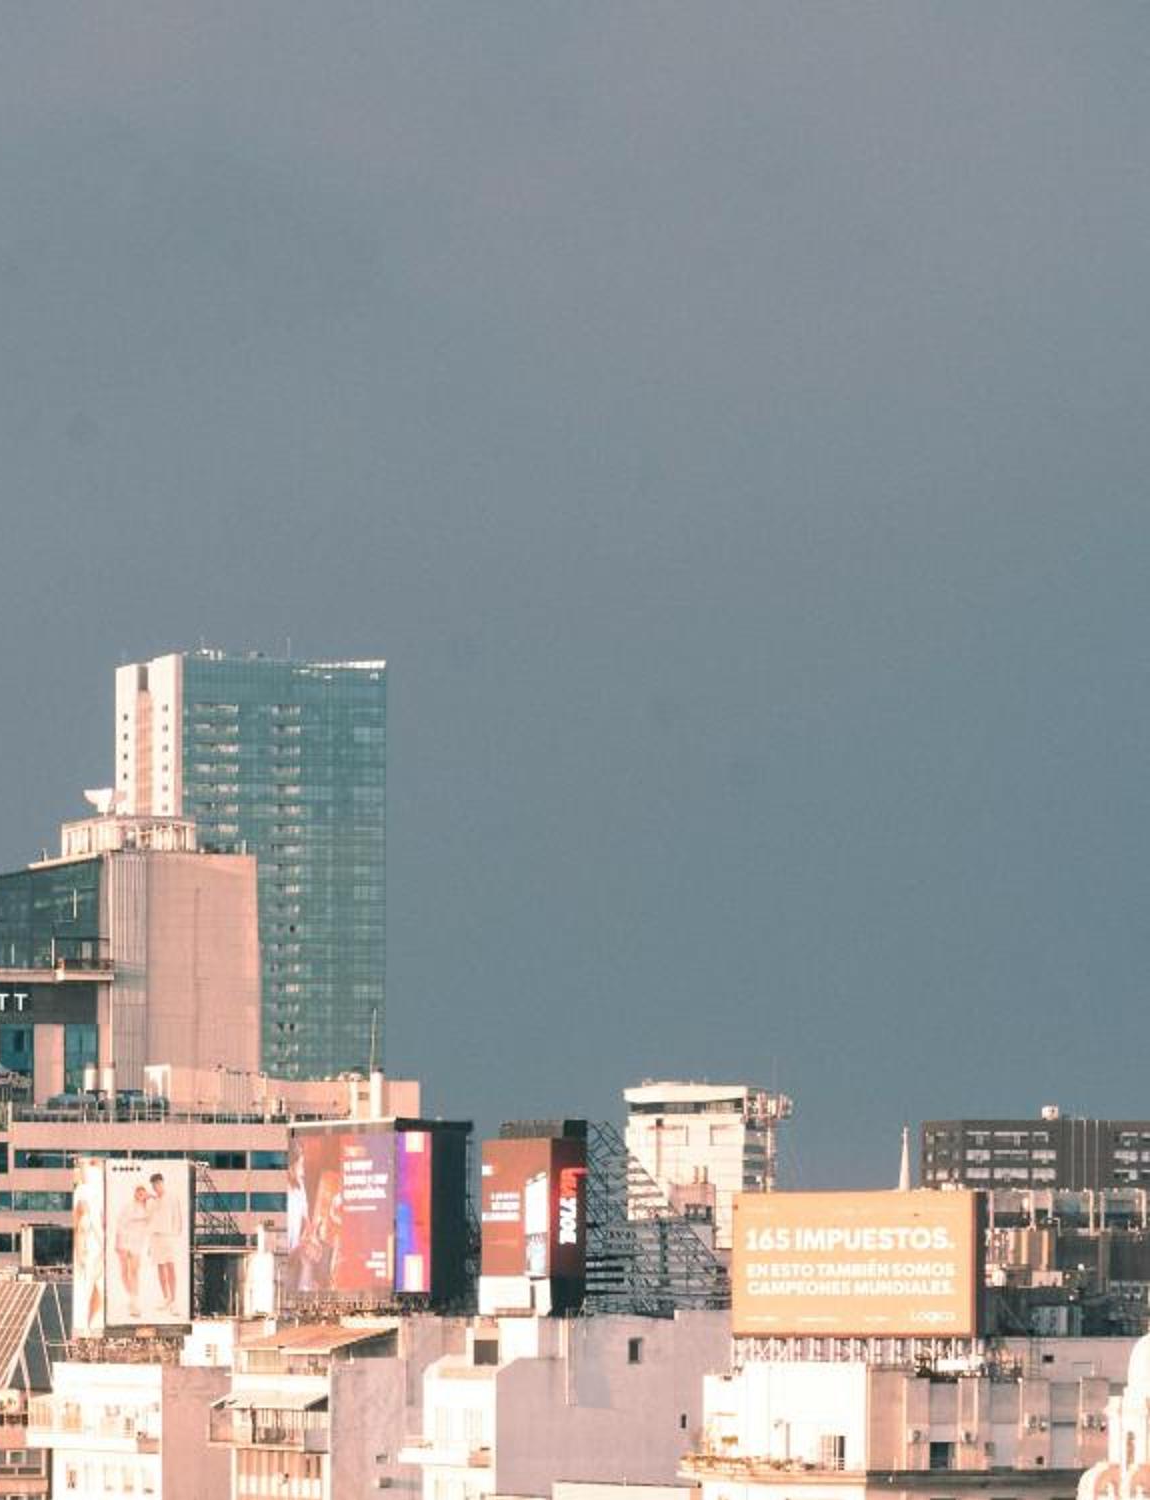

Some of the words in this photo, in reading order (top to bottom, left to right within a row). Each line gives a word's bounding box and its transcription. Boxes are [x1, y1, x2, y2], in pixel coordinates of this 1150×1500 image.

[746, 1228, 790, 1251] 165
[796, 1227, 955, 1250] IMPUESTOS.
[746, 1263, 768, 1277] EN
[770, 1263, 814, 1277] ESTO
[817, 1258, 890, 1277] TAMBIÉN
[892, 1263, 955, 1276] SOMOS
[748, 1280, 850, 1295] CAMPEONES
[853, 1280, 955, 1295] MUNDIALES.
